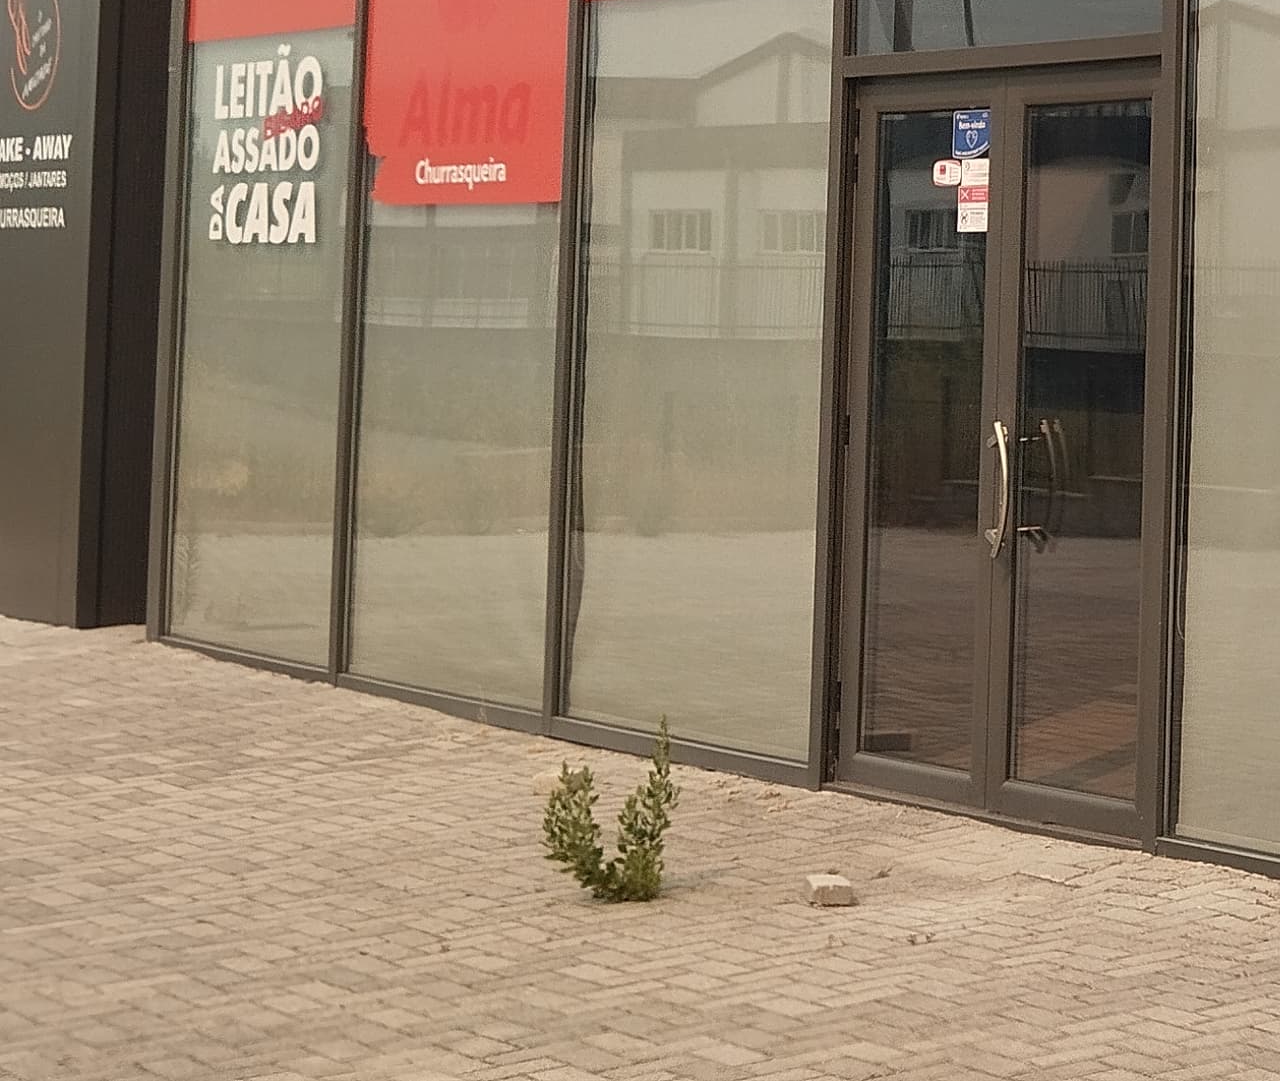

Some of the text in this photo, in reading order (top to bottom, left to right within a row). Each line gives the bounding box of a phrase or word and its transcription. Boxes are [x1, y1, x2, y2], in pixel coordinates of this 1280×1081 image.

[214, 43, 323, 120] LEITÃO
[399, 77, 532, 148] Alma
[32, 134, 73, 160] AWAY
[212, 124, 320, 174] ASSADO
[415, 157, 507, 191] Churrasqueira
[209, 181, 316, 244] DA CASA
